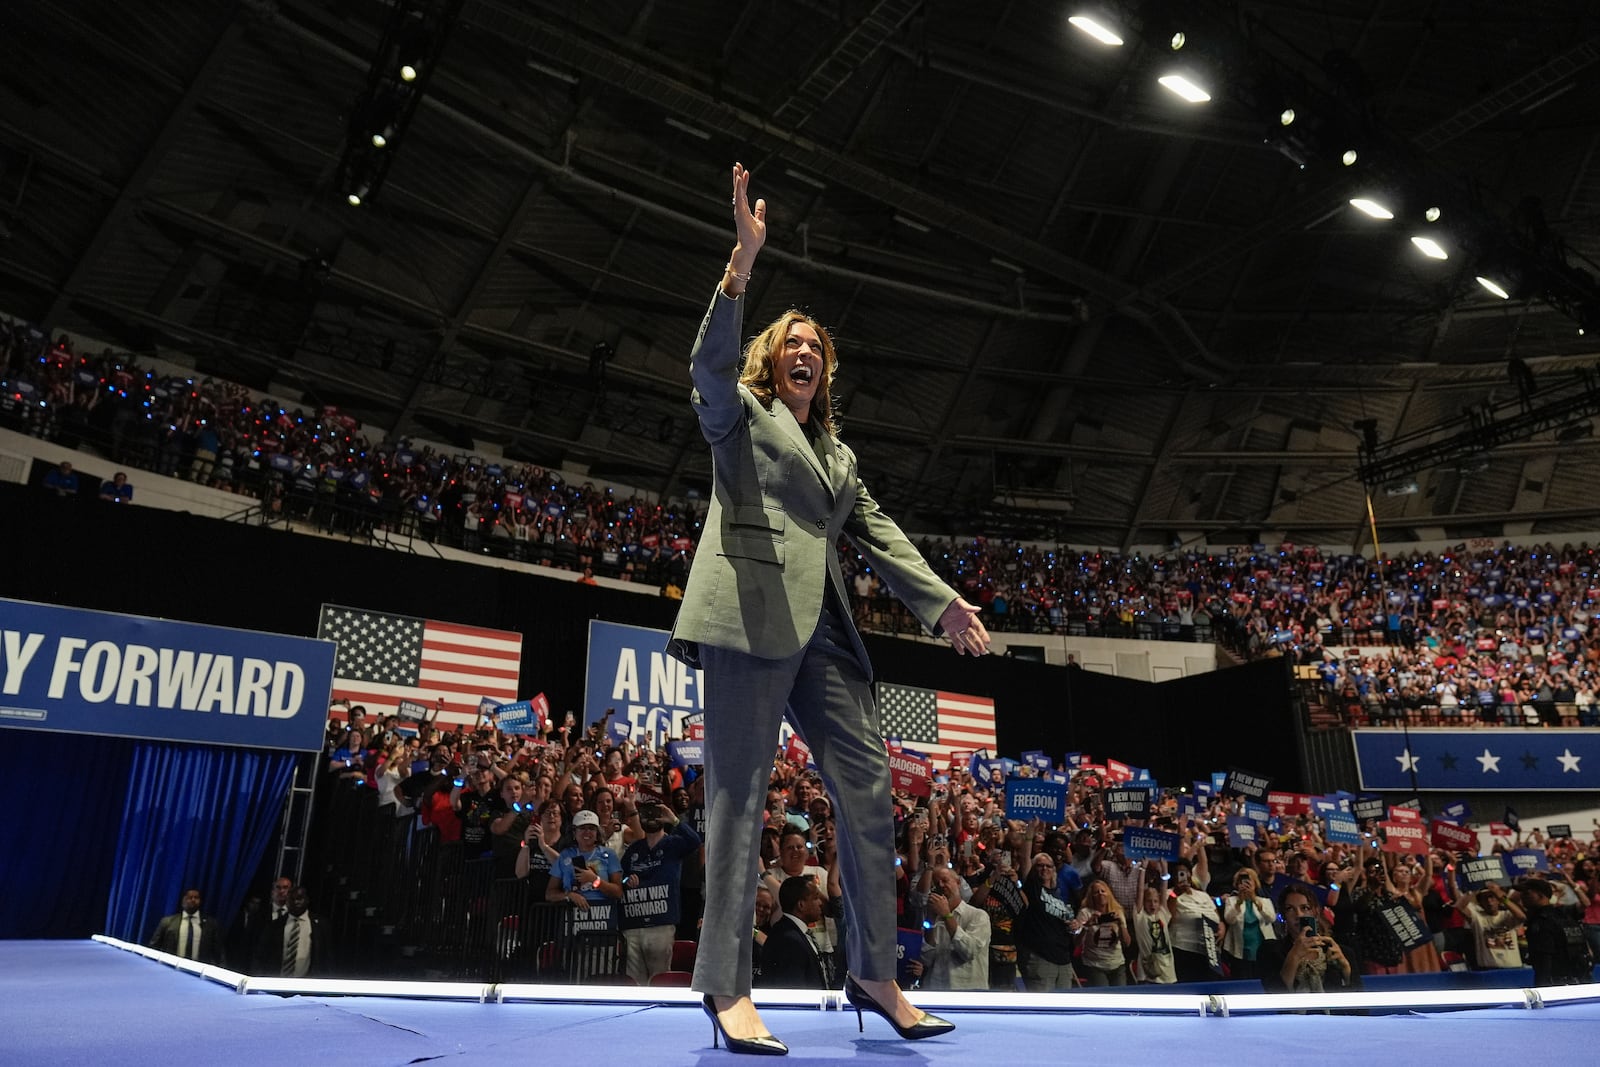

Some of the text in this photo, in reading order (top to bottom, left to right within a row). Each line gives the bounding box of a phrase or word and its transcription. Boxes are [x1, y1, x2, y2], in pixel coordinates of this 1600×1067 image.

[0, 629, 305, 720] Y FORWARD
[612, 648, 640, 702] A
[499, 709, 528, 721] FREEDOM
[889, 756, 926, 777] BADGERS
[1229, 771, 1269, 789] A NEW WAY
[1229, 780, 1263, 797] FORWARD
[1013, 794, 1058, 810] FREEDOM
[1107, 791, 1145, 803] A NEW WAY
[1111, 801, 1143, 813] FORWARD
[1386, 826, 1422, 839] BADGERS
[1437, 825, 1471, 843] BADGERS
[1130, 835, 1172, 851] FREEDOM
[1462, 863, 1468, 873] A
[1467, 860, 1486, 872] NEW
[1467, 869, 1503, 883] FORWARD
[626, 887, 651, 902] NEW
[648, 885, 669, 900] WAY
[994, 882, 1021, 916] ORWARD
[590, 905, 611, 920] WAY
[624, 899, 668, 918] FORWARD
